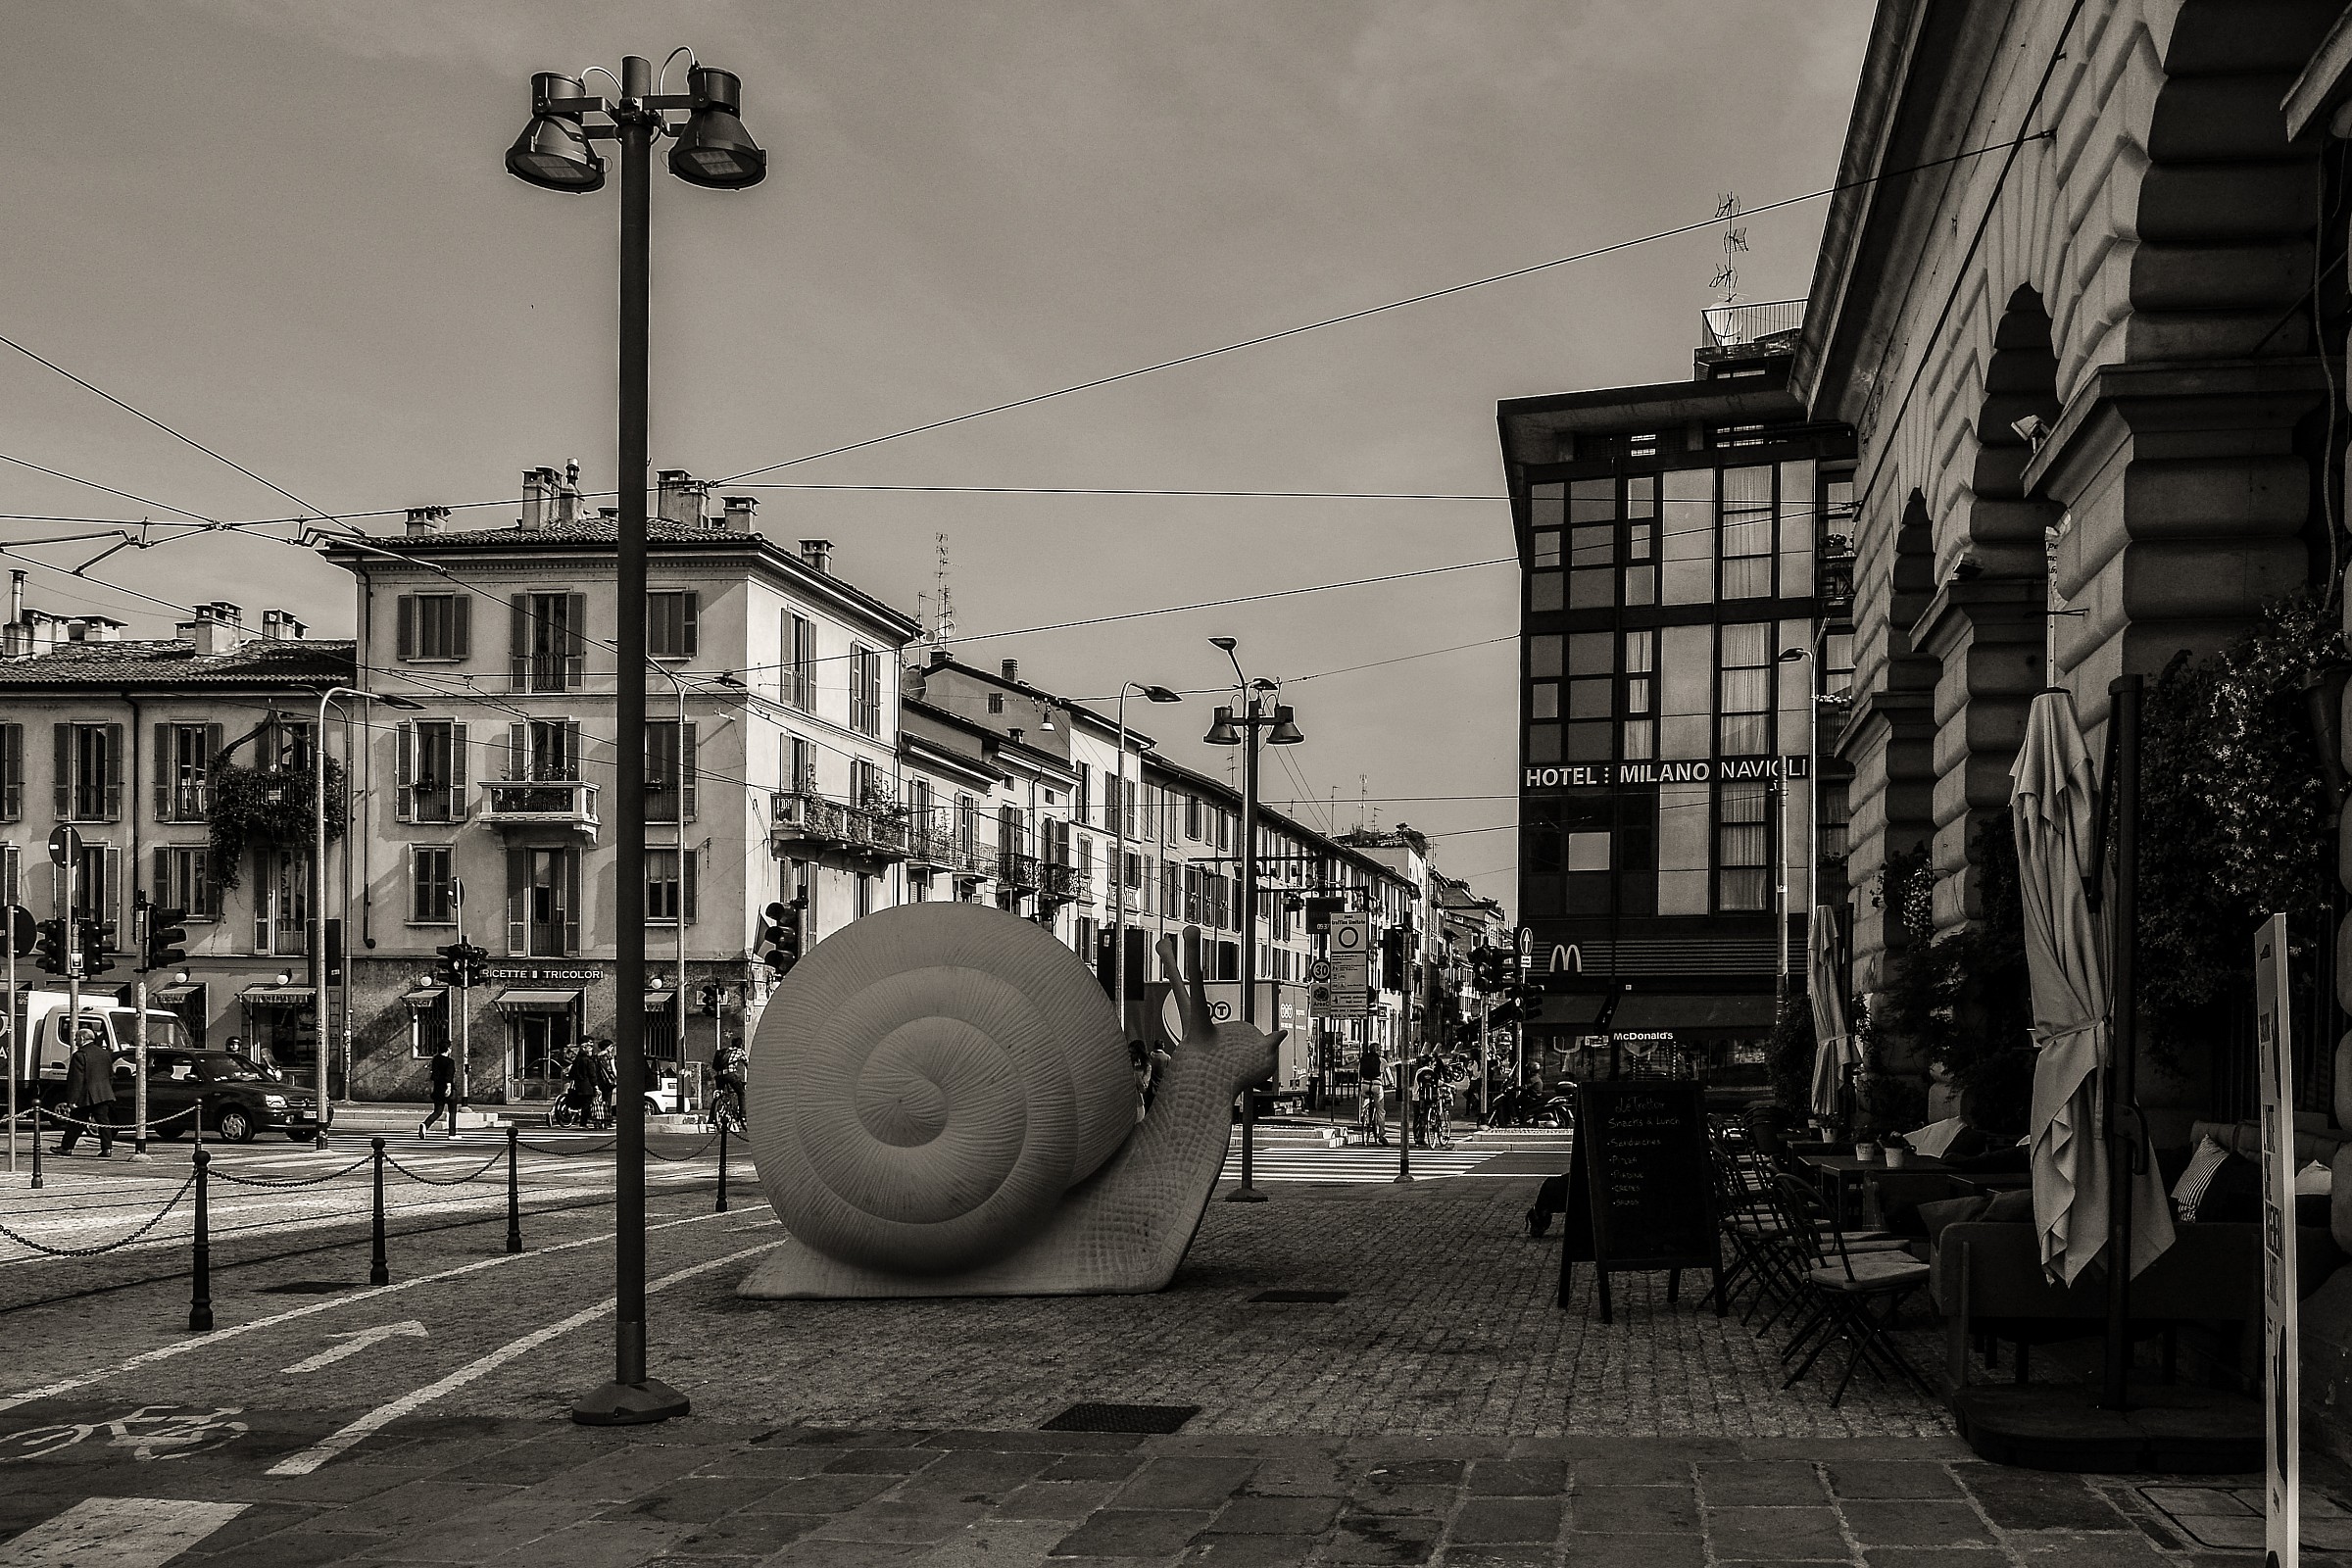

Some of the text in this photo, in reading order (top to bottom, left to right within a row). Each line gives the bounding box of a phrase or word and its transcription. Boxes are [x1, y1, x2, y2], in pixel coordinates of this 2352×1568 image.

[1526, 766, 1597, 787] HOTEL
[1619, 762, 1711, 784] MILANO
[482, 969, 604, 979] RICETTE TRICOLORI
[1315, 965, 1329, 976] 30
[1613, 1032, 1674, 1041] McDonald's
[1608, 1117, 1643, 1129] Snacks
[1656, 1115, 1681, 1127] Lunch
